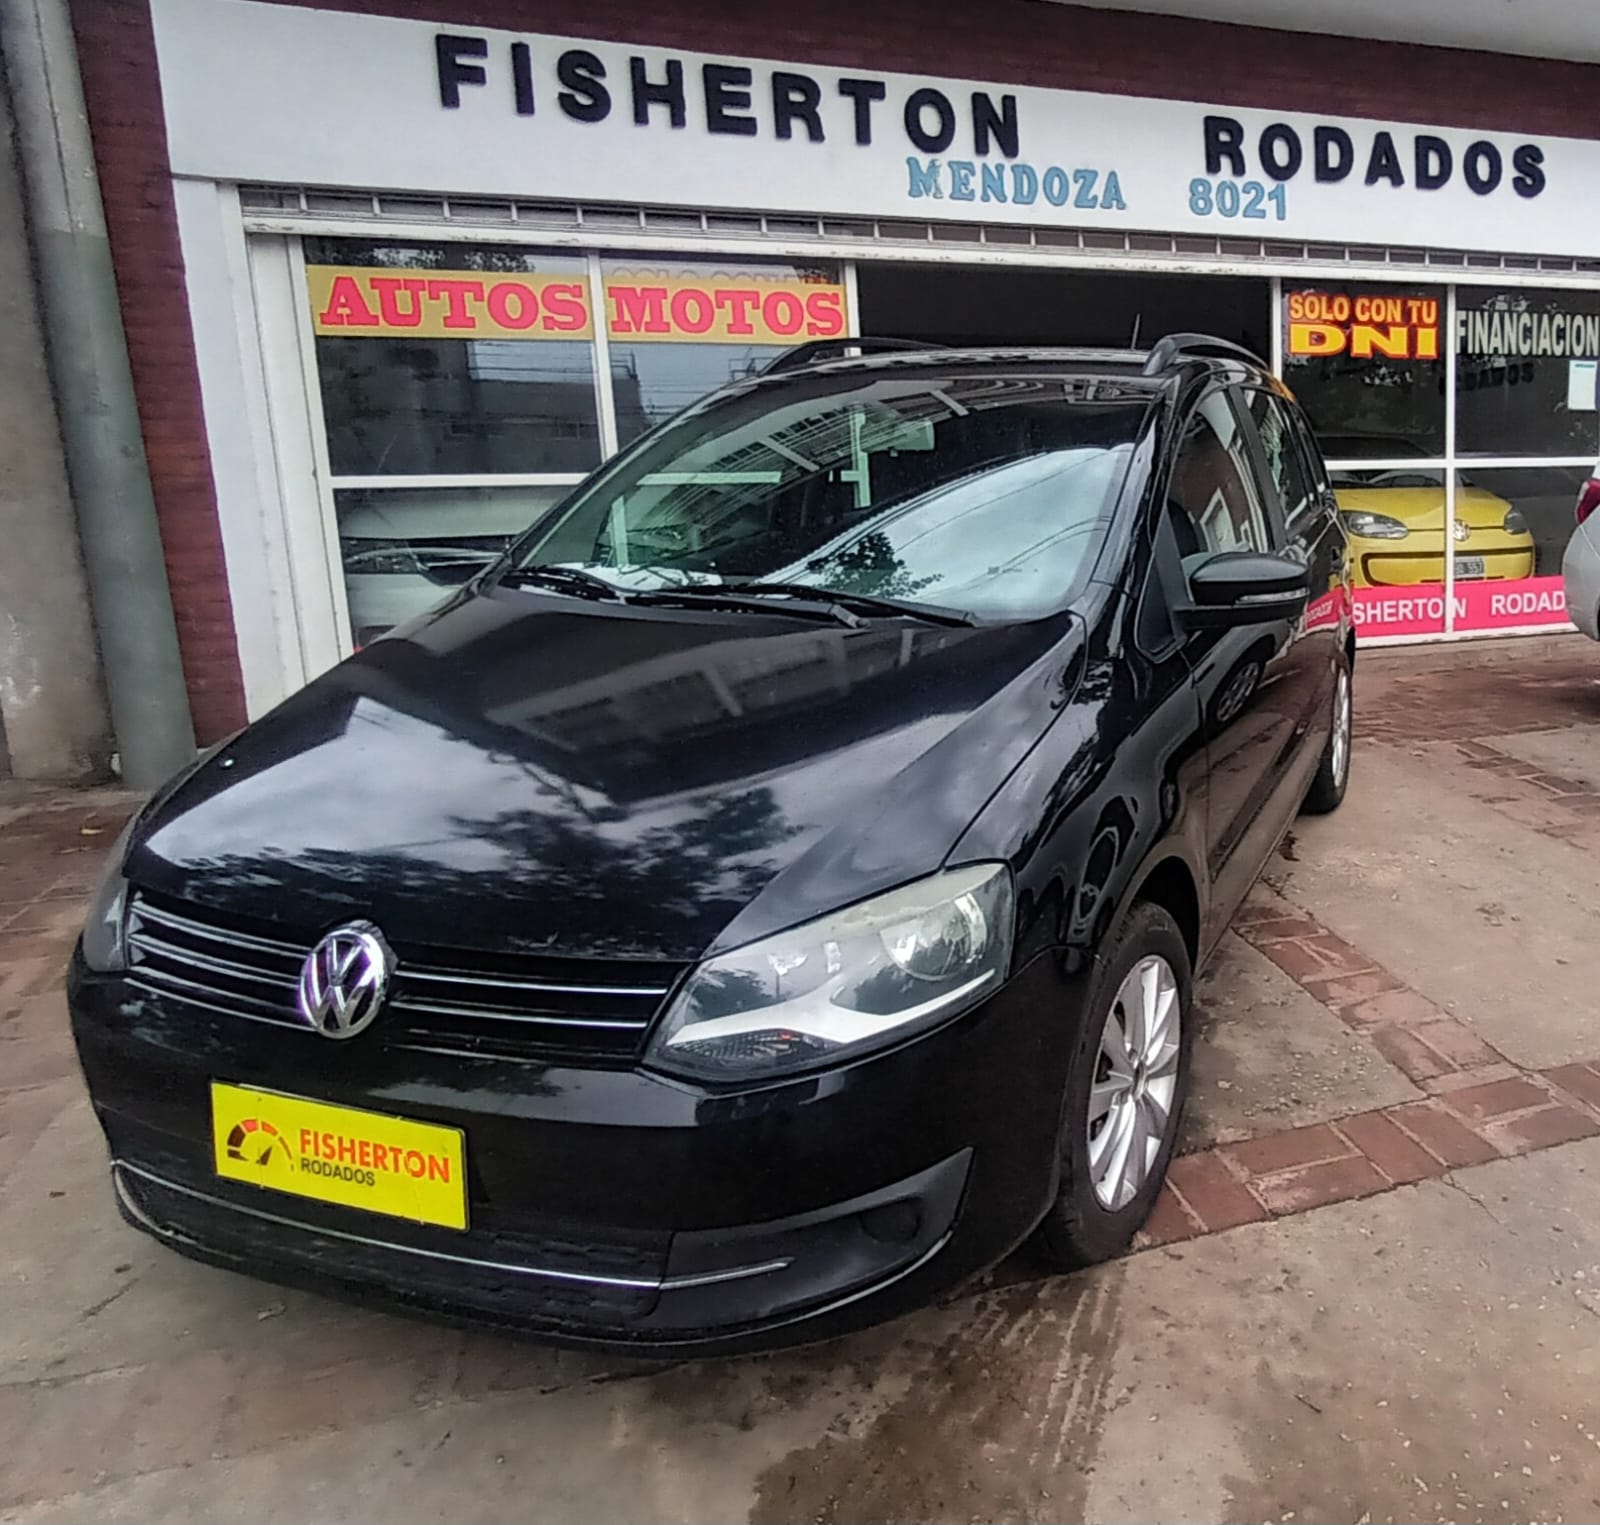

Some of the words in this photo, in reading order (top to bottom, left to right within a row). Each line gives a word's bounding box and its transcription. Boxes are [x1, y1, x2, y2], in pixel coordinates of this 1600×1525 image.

[434, 34, 1019, 158] FISHERTON
[1203, 115, 1546, 198] RODADOS
[906, 156, 1126, 210] MENDOZA
[1189, 178, 1286, 220] 8021
[319, 275, 588, 331] AUTOS
[607, 286, 843, 336] MOTOS
[1289, 294, 1349, 322] SOLO
[1355, 298, 1402, 323] CON
[1408, 300, 1437, 325] TU
[1288, 322, 1437, 358] DNI
[1455, 310, 1600, 357] FINANCIACION
[1352, 597, 1467, 624] SHERTON
[1491, 590, 1566, 616] RODAD
[299, 1128, 450, 1184] FISHERTON
[300, 1157, 376, 1187] RODADOS
